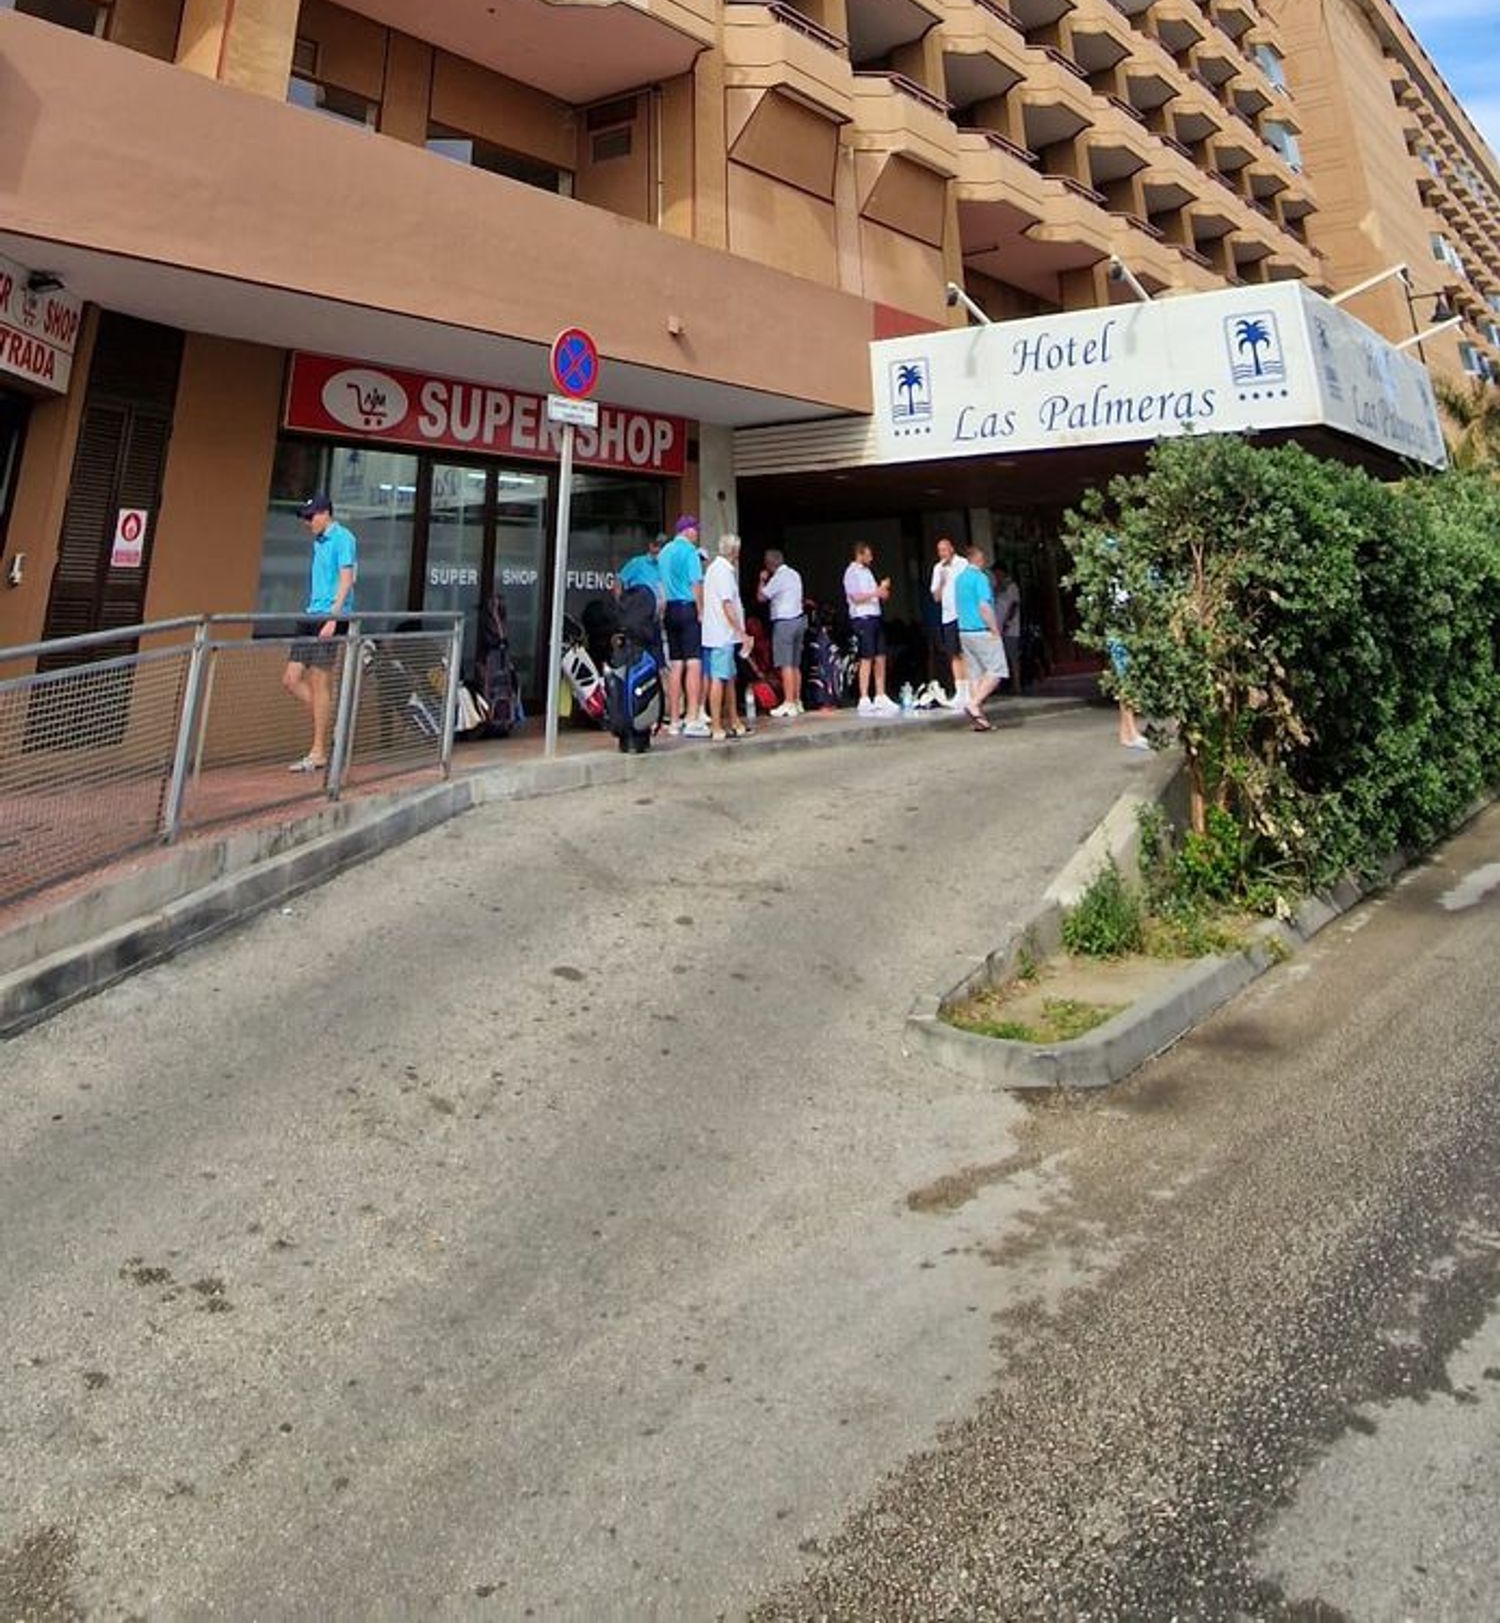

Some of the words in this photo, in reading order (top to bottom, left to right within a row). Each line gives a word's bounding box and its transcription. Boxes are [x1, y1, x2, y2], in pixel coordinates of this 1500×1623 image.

[44, 299, 77, 343] SHOP
[1013, 320, 1115, 375] Hotel
[953, 406, 1016, 442] Las
[1039, 384, 1216, 432] Palmeras
[430, 568, 478, 585] SUPER
[502, 570, 538, 585] SHOP
